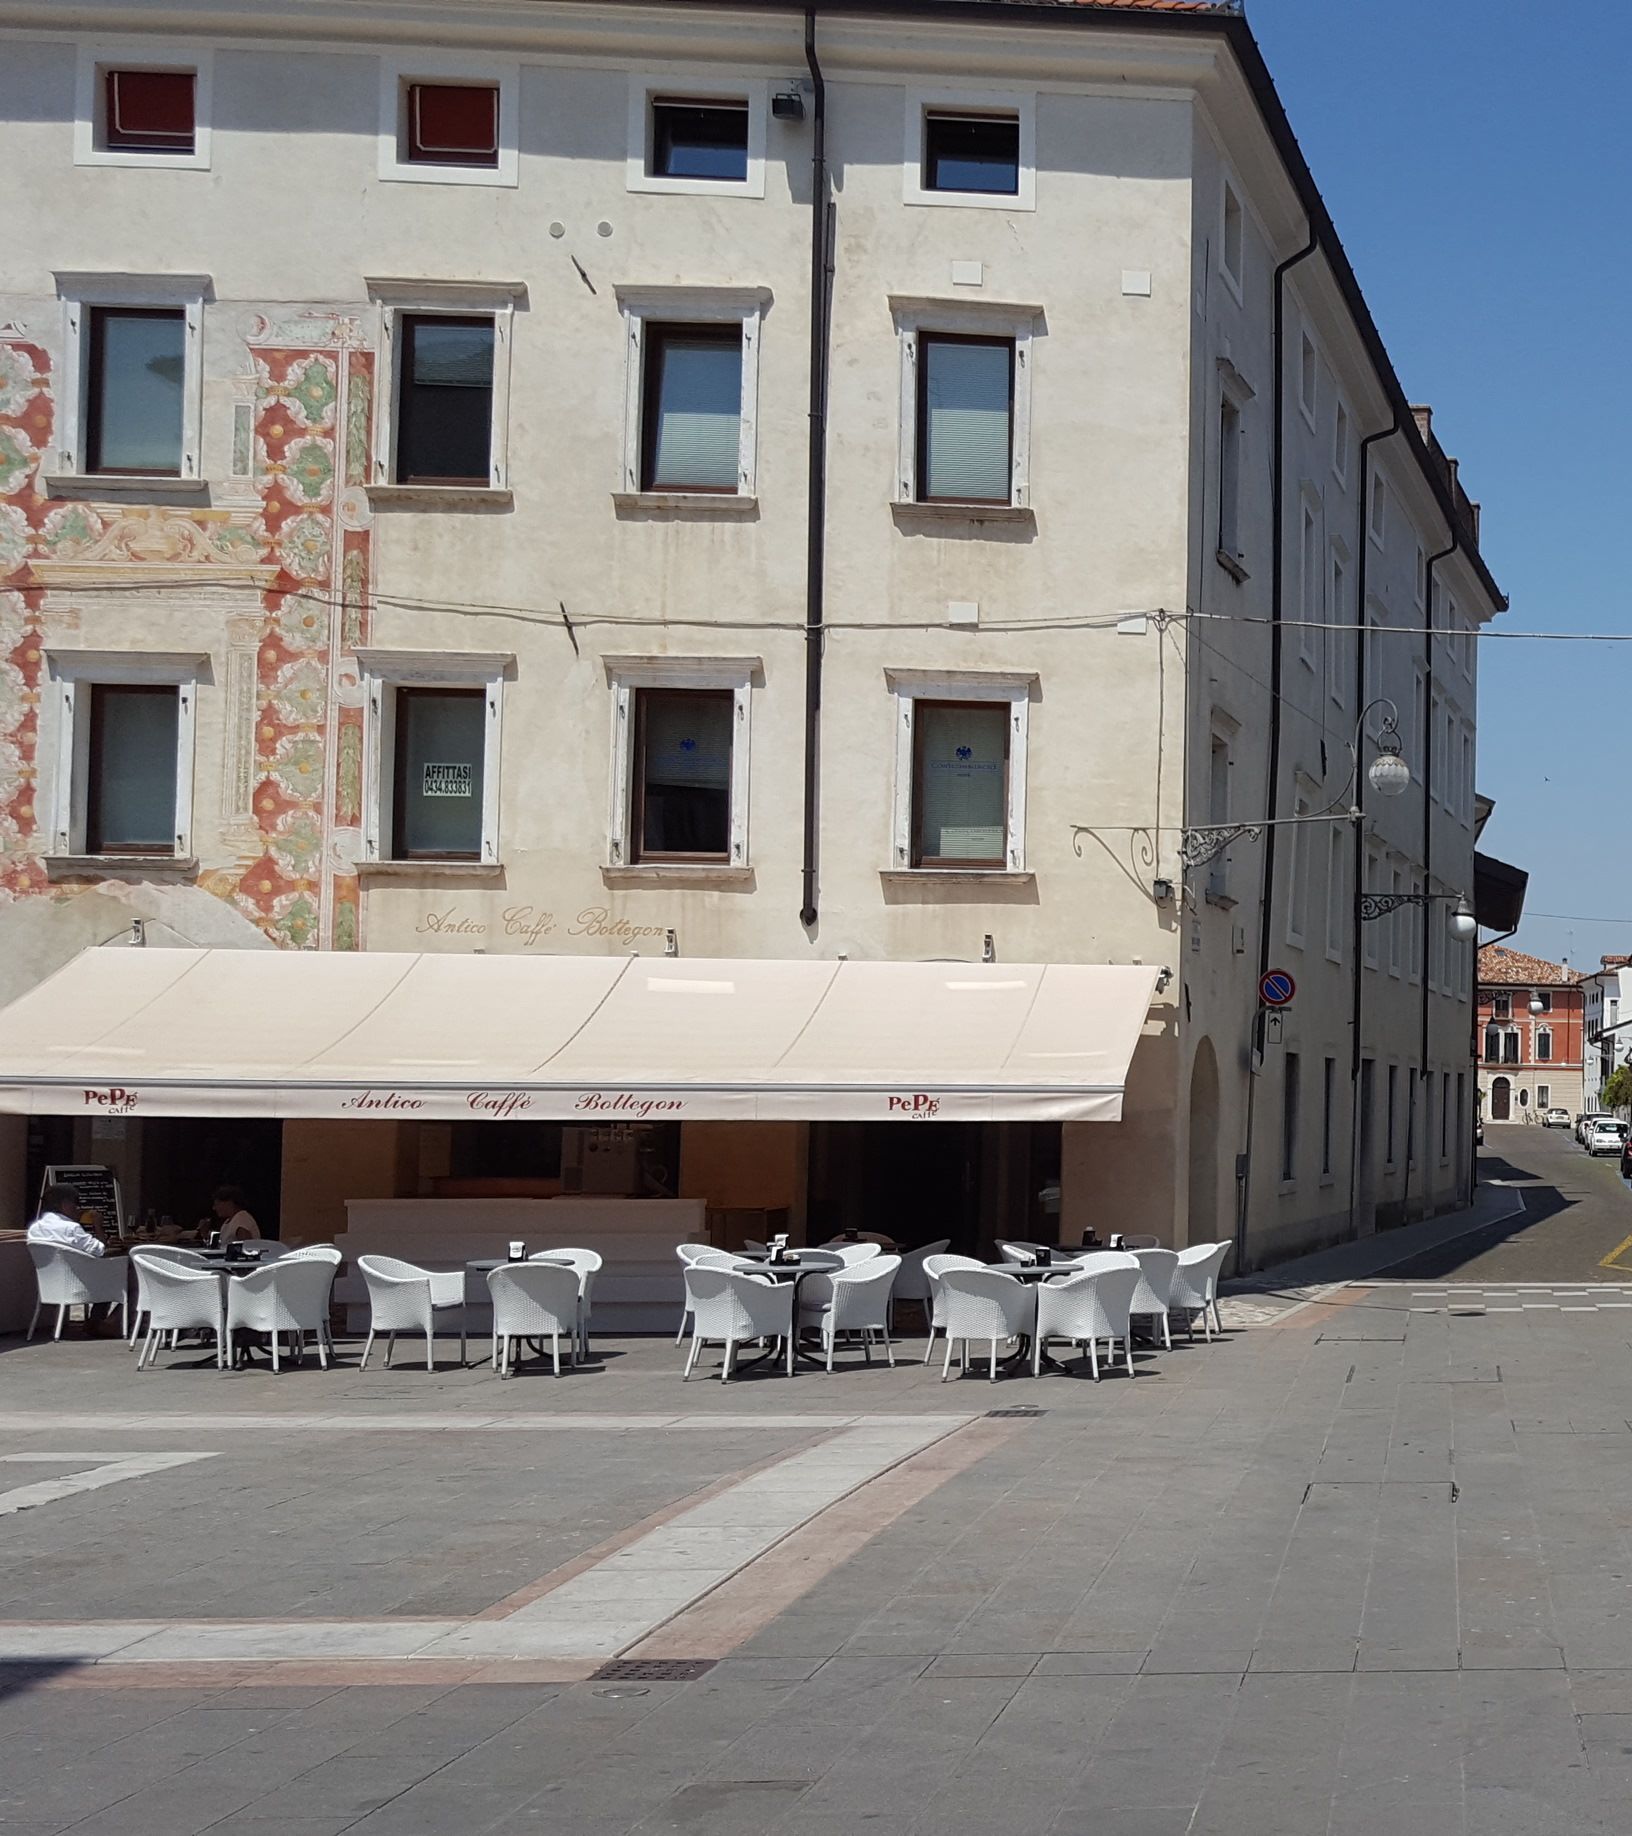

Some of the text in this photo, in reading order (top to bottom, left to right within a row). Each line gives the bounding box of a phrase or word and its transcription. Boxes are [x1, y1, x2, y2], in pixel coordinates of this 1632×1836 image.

[424, 765, 472, 780] AFFITTASI
[416, 907, 489, 935] Antico
[567, 906, 665, 946] Bottegon
[340, 1091, 427, 1110] Antico
[573, 1093, 689, 1118] Bottegon
